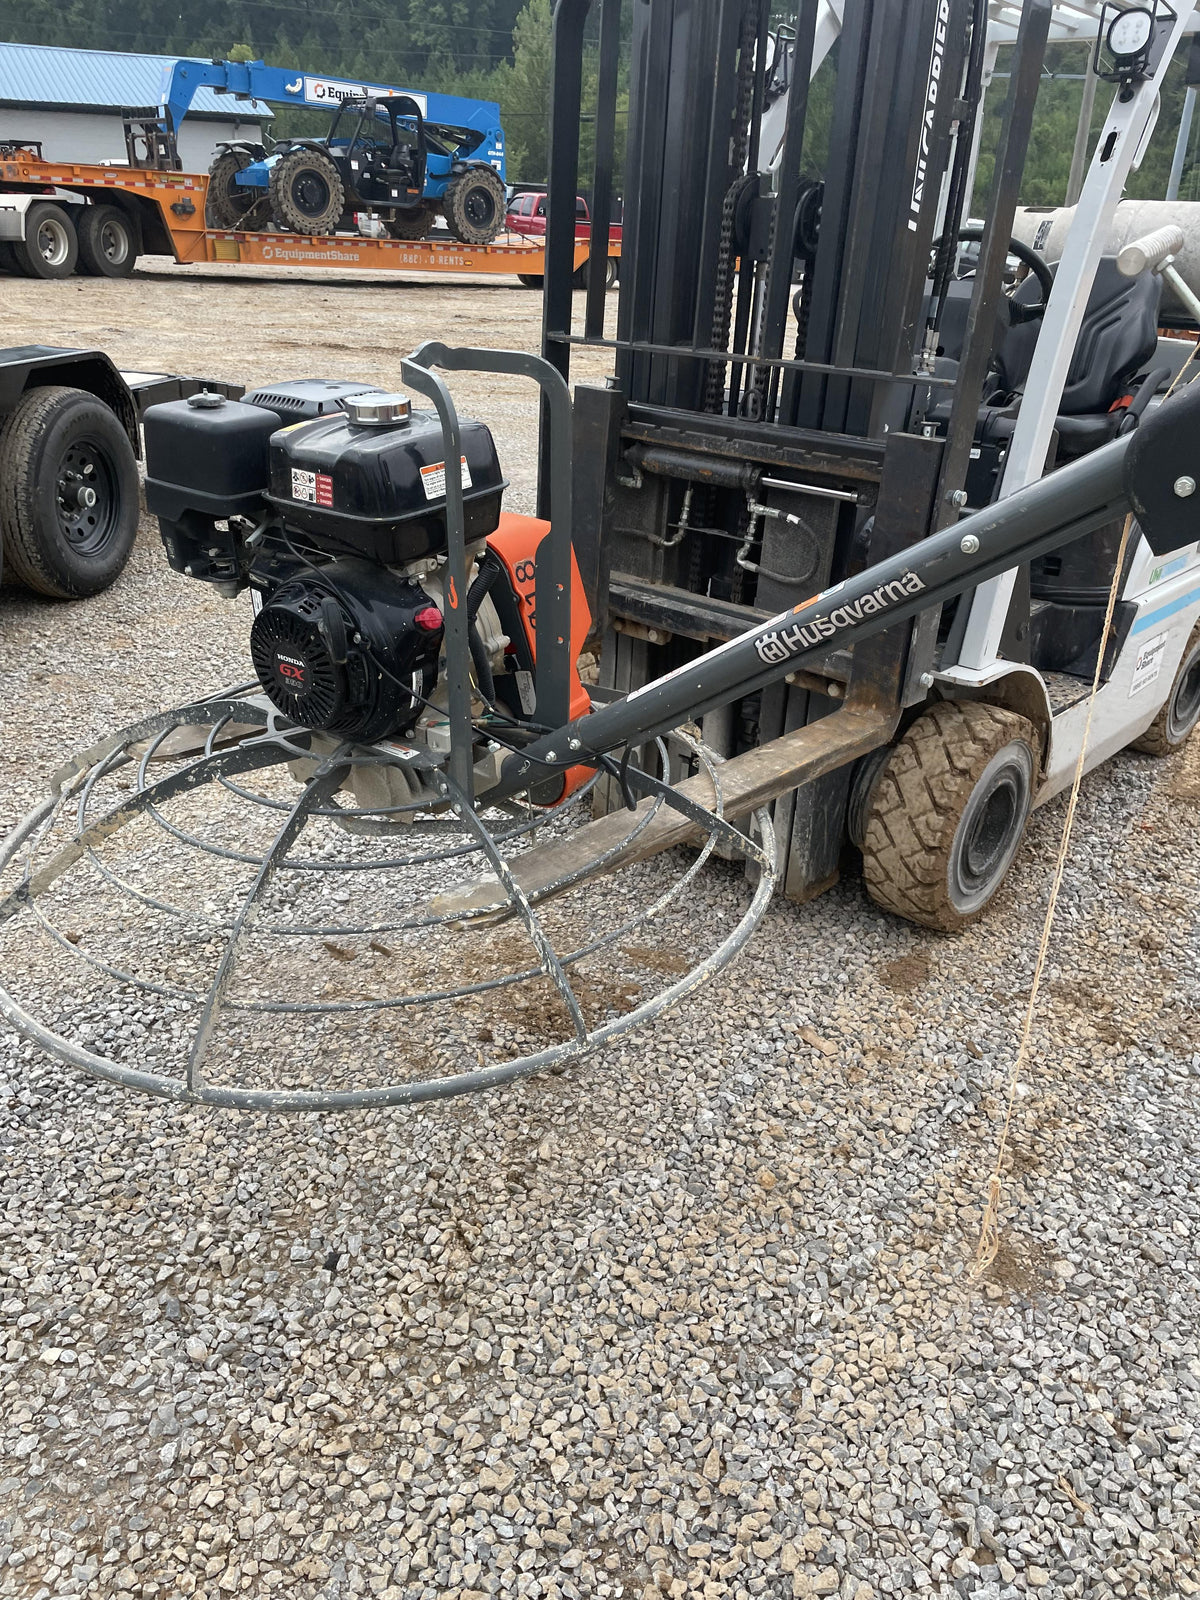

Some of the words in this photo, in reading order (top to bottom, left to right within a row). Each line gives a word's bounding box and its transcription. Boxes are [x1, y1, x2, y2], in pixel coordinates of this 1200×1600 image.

[275, 248, 360, 262] EquipmentShare
[780, 571, 926, 651] Husqvarna
[277, 653, 305, 667] HONDA
[280, 664, 304, 681] GX
